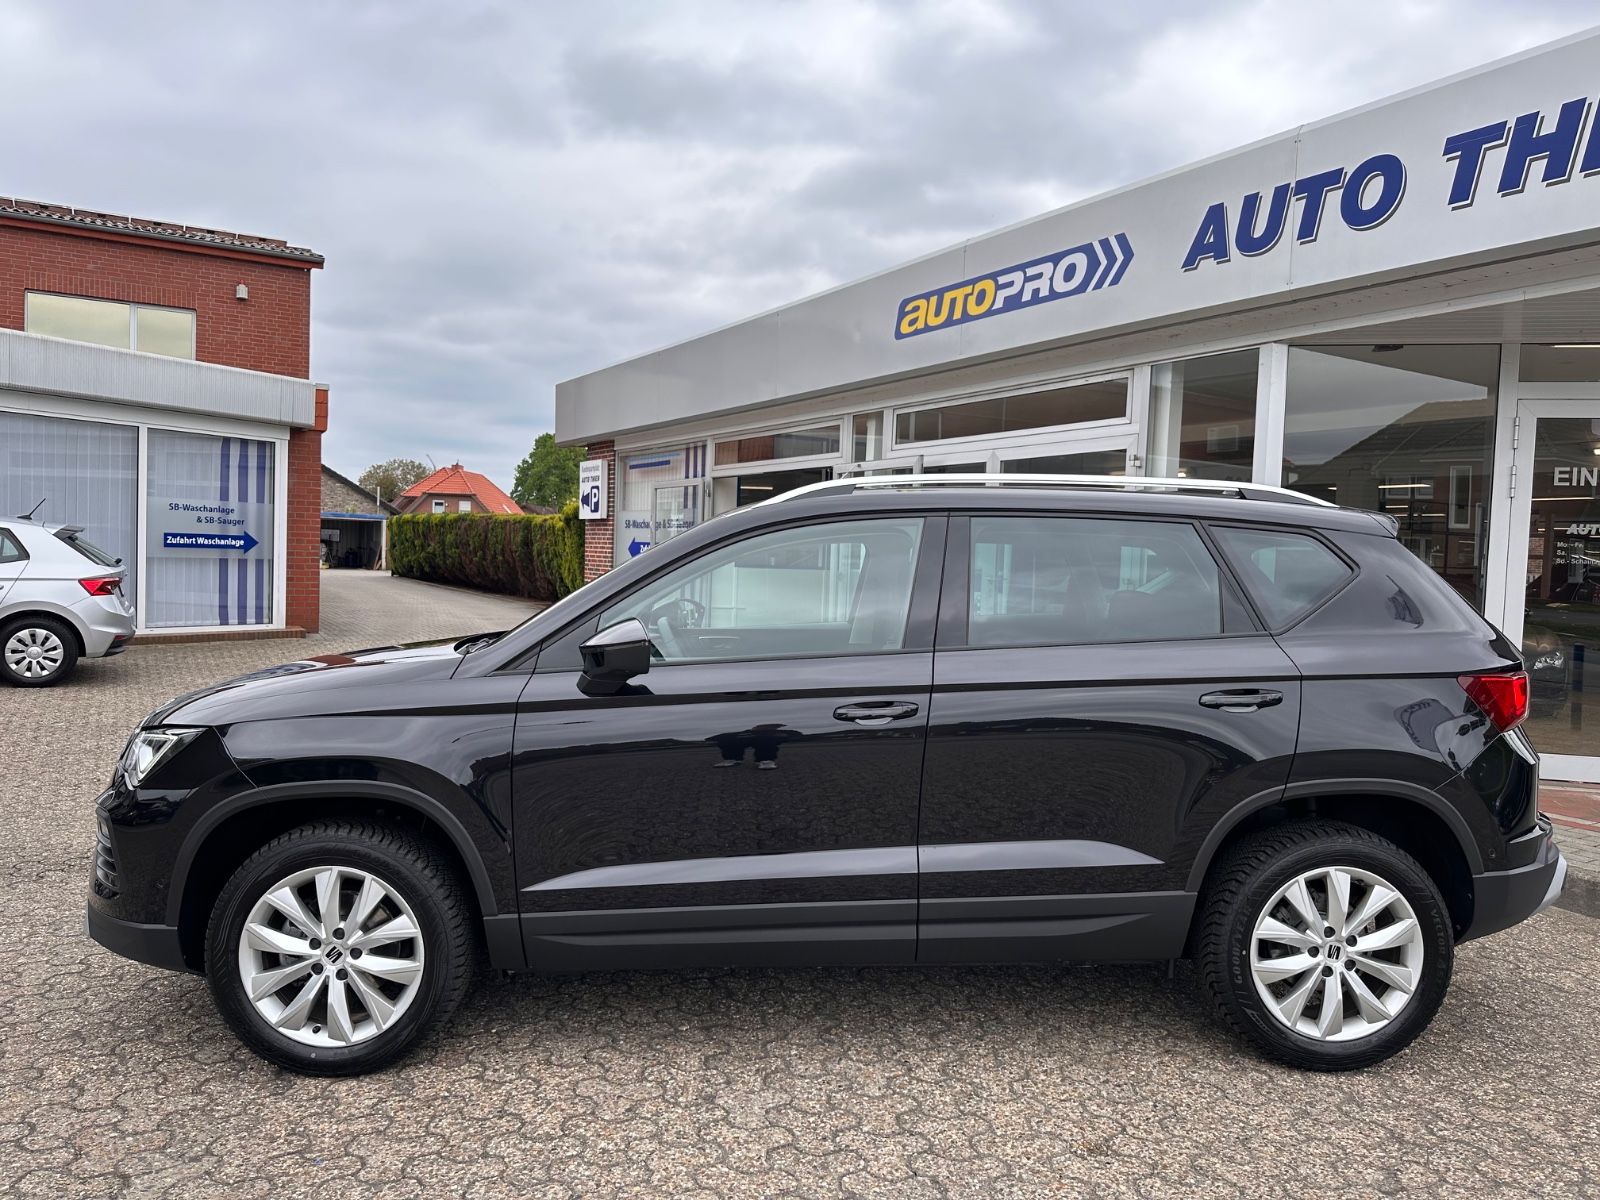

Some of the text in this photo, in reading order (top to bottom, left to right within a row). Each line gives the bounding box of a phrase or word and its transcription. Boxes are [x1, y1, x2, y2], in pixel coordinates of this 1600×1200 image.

[1181, 153, 1408, 273] AUTO
[1553, 466, 1598, 487] EIN
[168, 502, 235, 515] SB-Waschanlage
[204, 516, 245, 526] SB-Sauger
[1566, 523, 1600, 536] AUT
[166, 535, 245, 548] Zufahrt Waschanlage
